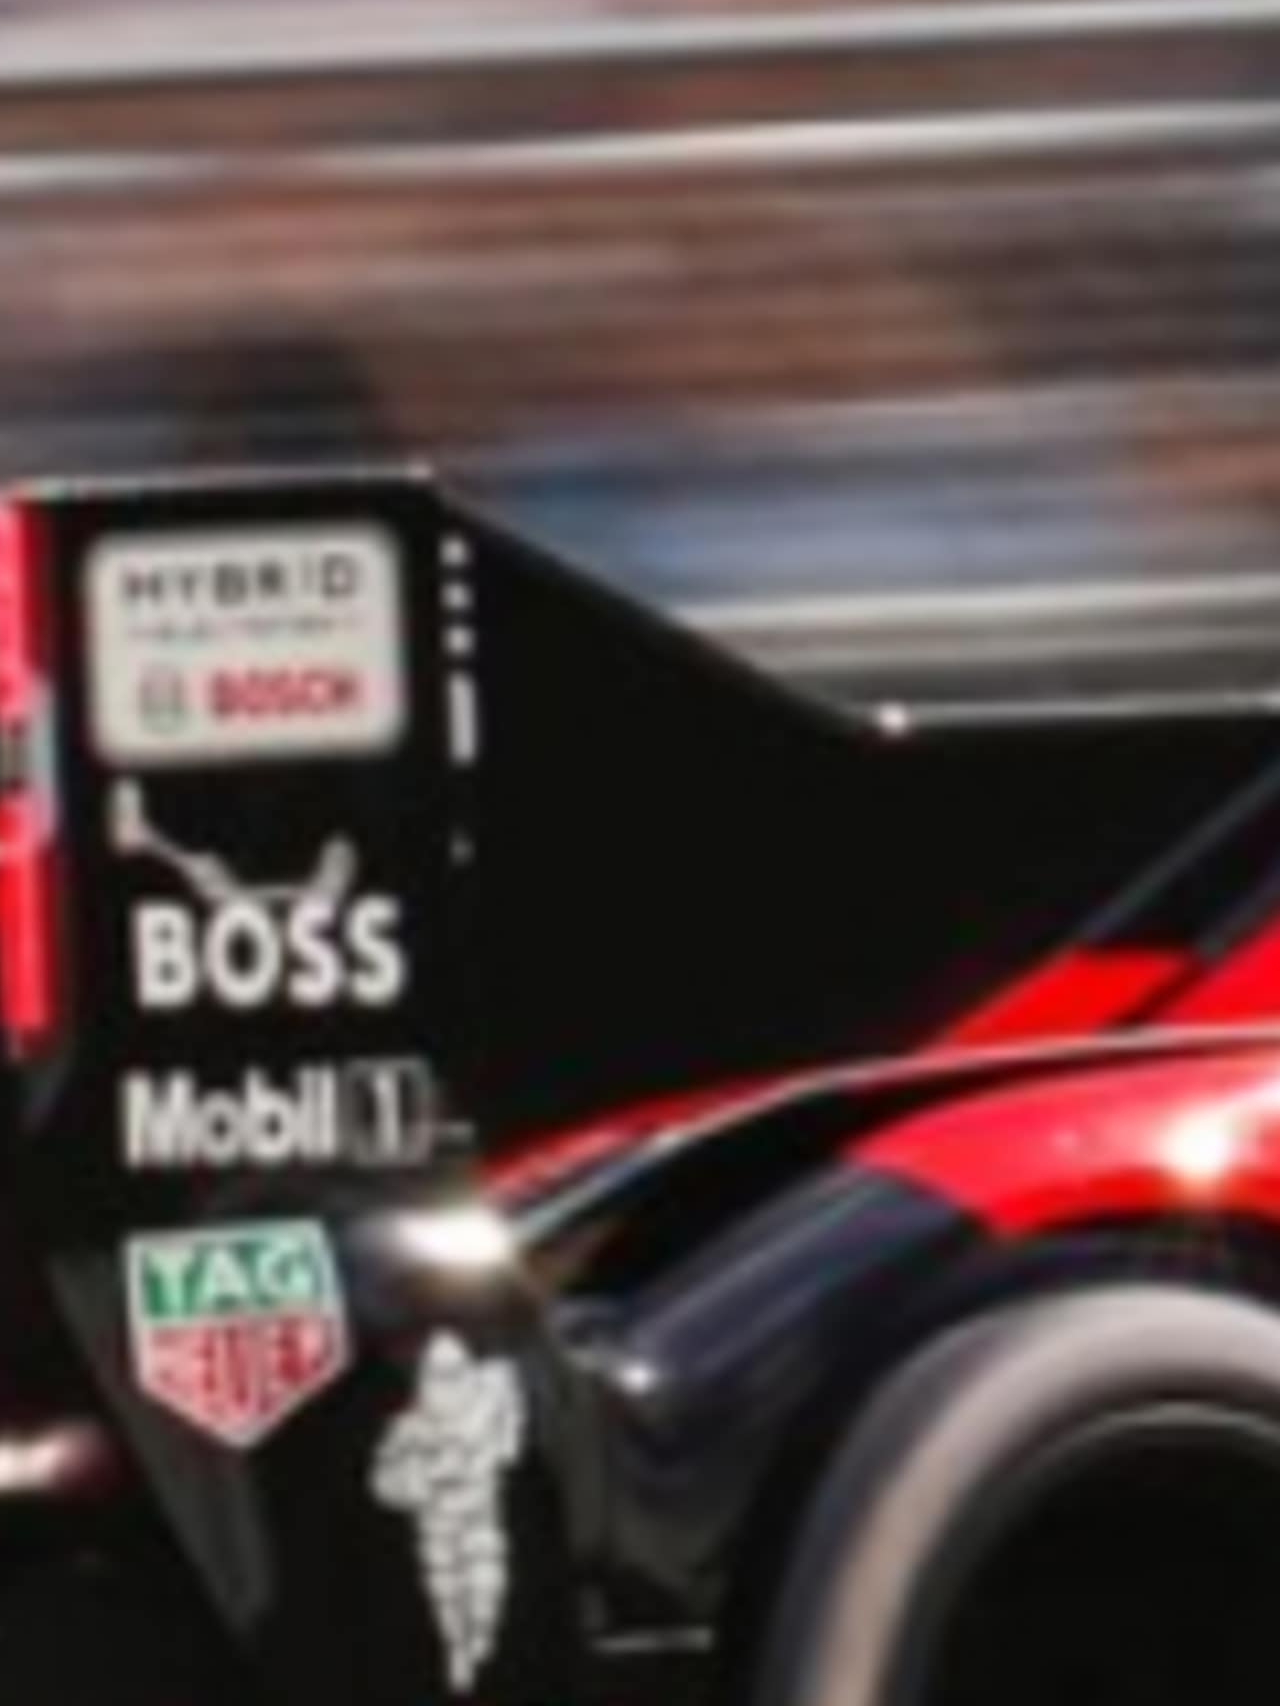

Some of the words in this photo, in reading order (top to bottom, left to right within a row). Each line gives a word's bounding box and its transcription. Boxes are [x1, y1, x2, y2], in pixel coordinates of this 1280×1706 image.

[122, 552, 362, 608] HYBRID
[207, 666, 365, 723] BOSCH
[130, 895, 406, 1008] BOSS
[124, 1066, 337, 1168] Mobil
[142, 1236, 317, 1322] TAG
